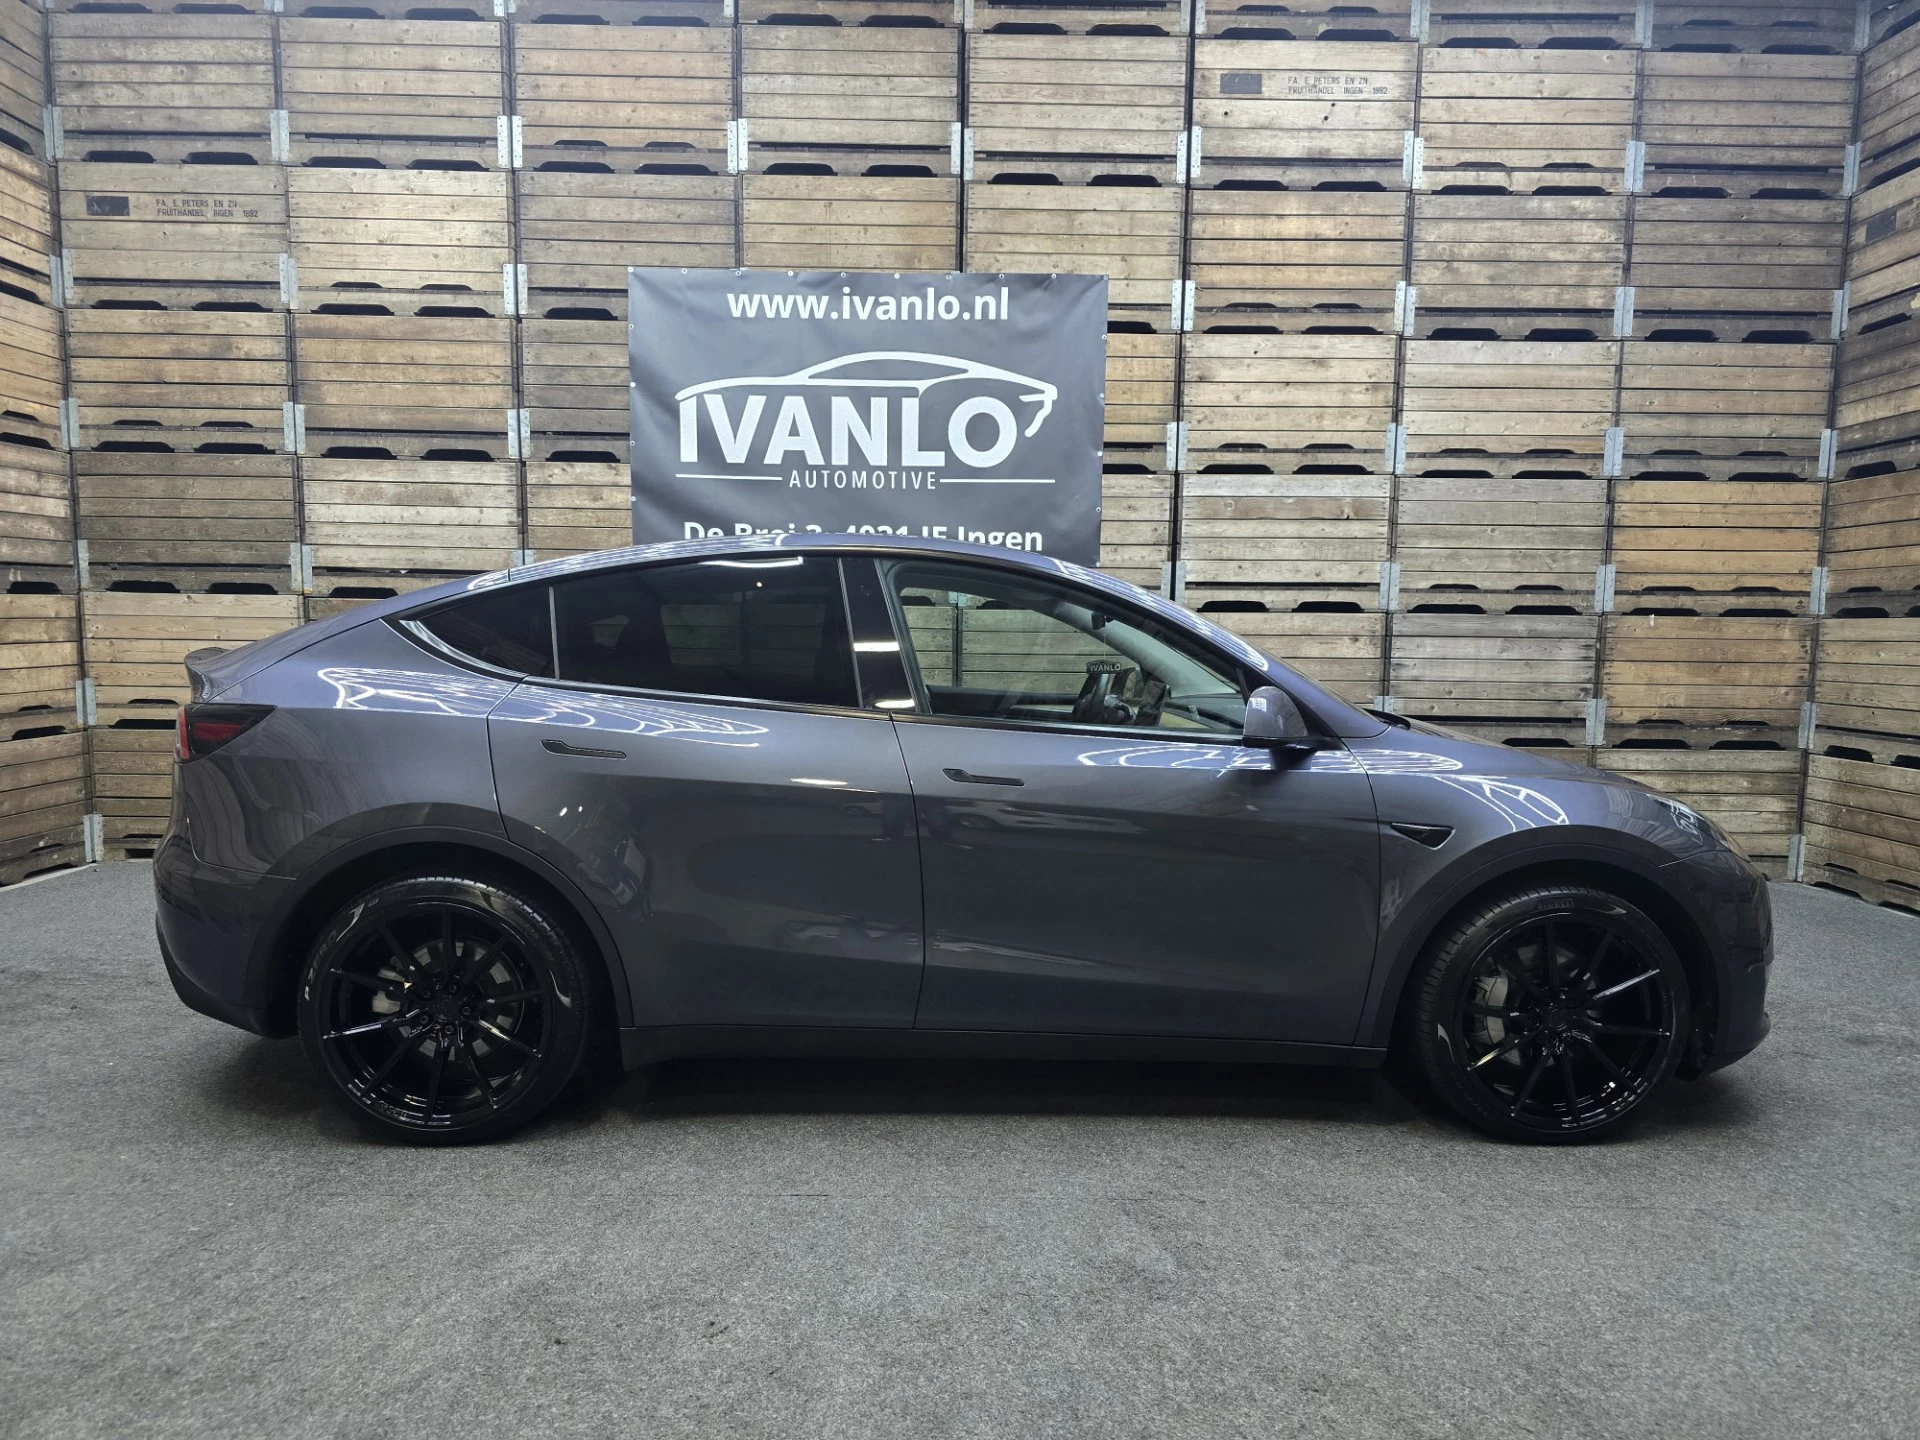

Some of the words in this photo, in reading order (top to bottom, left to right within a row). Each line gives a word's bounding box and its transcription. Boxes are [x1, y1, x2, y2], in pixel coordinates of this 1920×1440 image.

[1313, 76, 1341, 85] PETERS
[1345, 76, 1355, 85] EN
[1358, 76, 1368, 85] ZN
[1288, 86, 1335, 95] FRUITHANDEL
[1343, 86, 1363, 95] INGEN
[182, 199, 209, 208] PETERS
[213, 200, 224, 208] EN
[157, 208, 205, 217] FRUITHANDEL
[213, 209, 234, 218] INGEN
[727, 286, 1009, 321] www.ivanlo.nl
[679, 393, 1018, 468] IVANLO
[788, 469, 936, 491] AUTOMOTIVE
